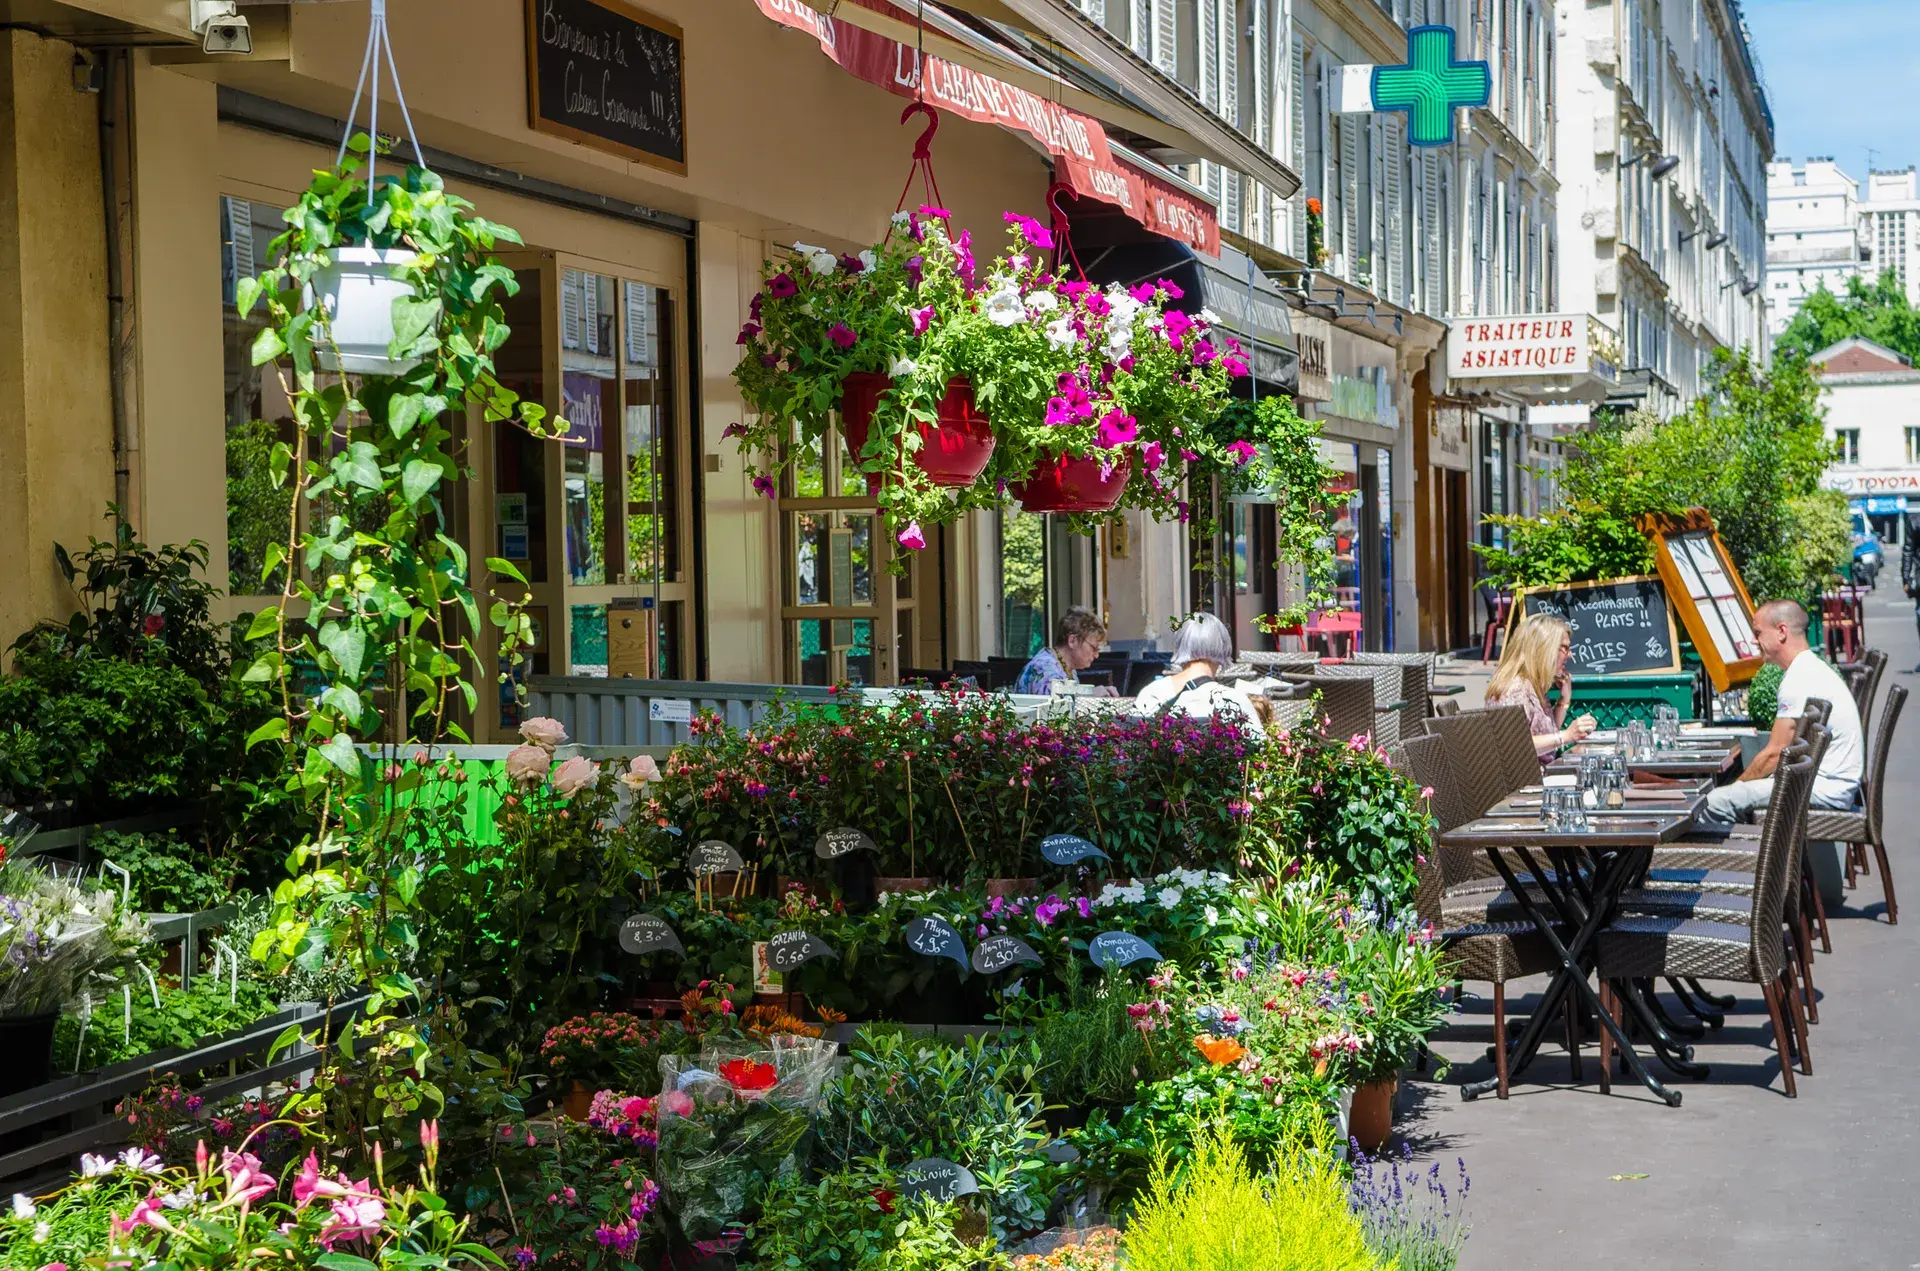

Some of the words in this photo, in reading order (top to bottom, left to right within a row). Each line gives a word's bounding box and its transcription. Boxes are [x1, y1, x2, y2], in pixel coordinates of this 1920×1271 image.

[615, 31, 628, 67] la
[565, 60, 600, 116] Cabane
[894, 42, 925, 93] LA
[928, 54, 1010, 116] CABANE
[1464, 320, 1574, 343] TRAITEUR
[1461, 346, 1577, 369] ASIATIQUE
[1857, 476, 1919, 489] TOYOTA
[1595, 612, 1634, 628] PLATS
[771, 930, 807, 946] GAZANIA
